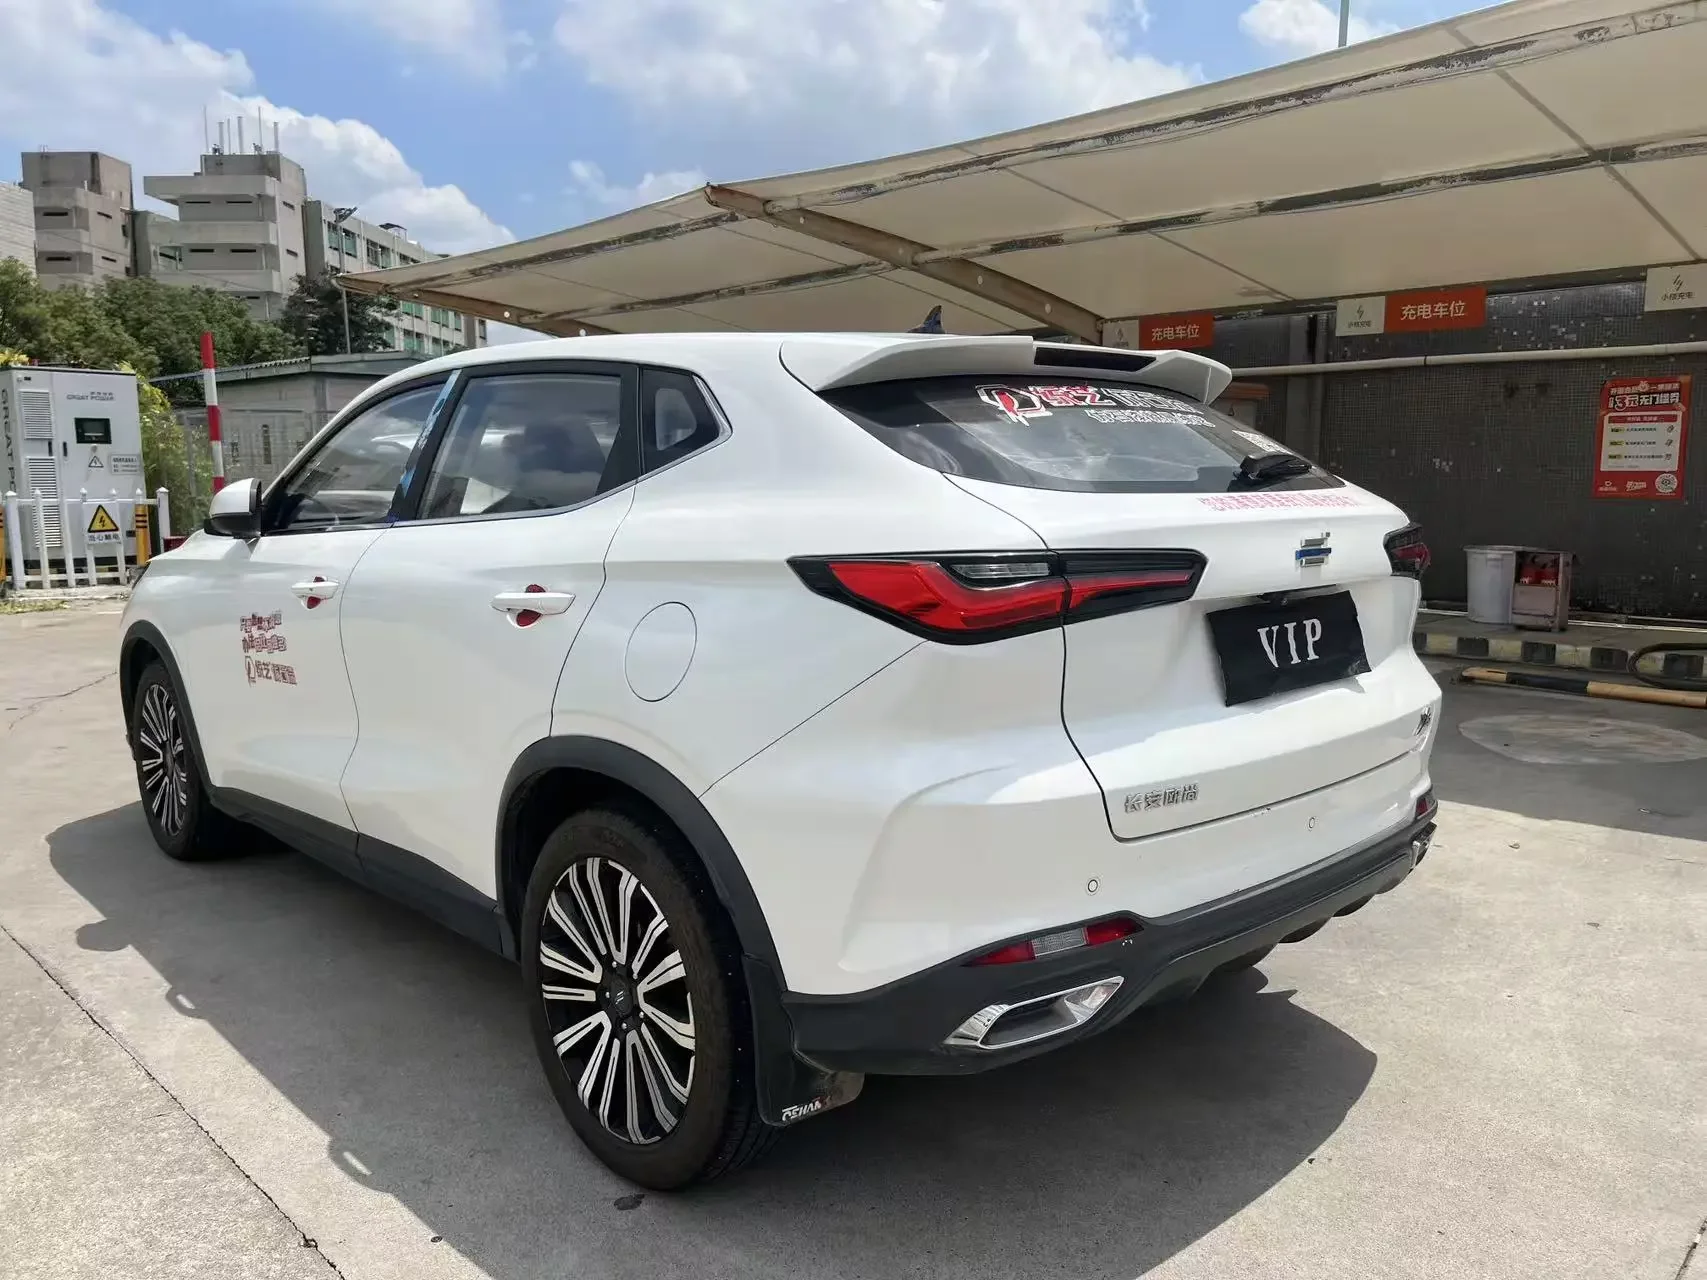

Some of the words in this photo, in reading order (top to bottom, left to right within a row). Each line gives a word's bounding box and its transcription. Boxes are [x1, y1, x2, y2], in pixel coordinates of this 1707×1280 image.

[1401, 300, 1466, 321] 充电车位
[1151, 323, 1201, 342] 充电车位
[1257, 618, 1322, 668] VIP
[1124, 782, 1199, 814] 长安欧尚
